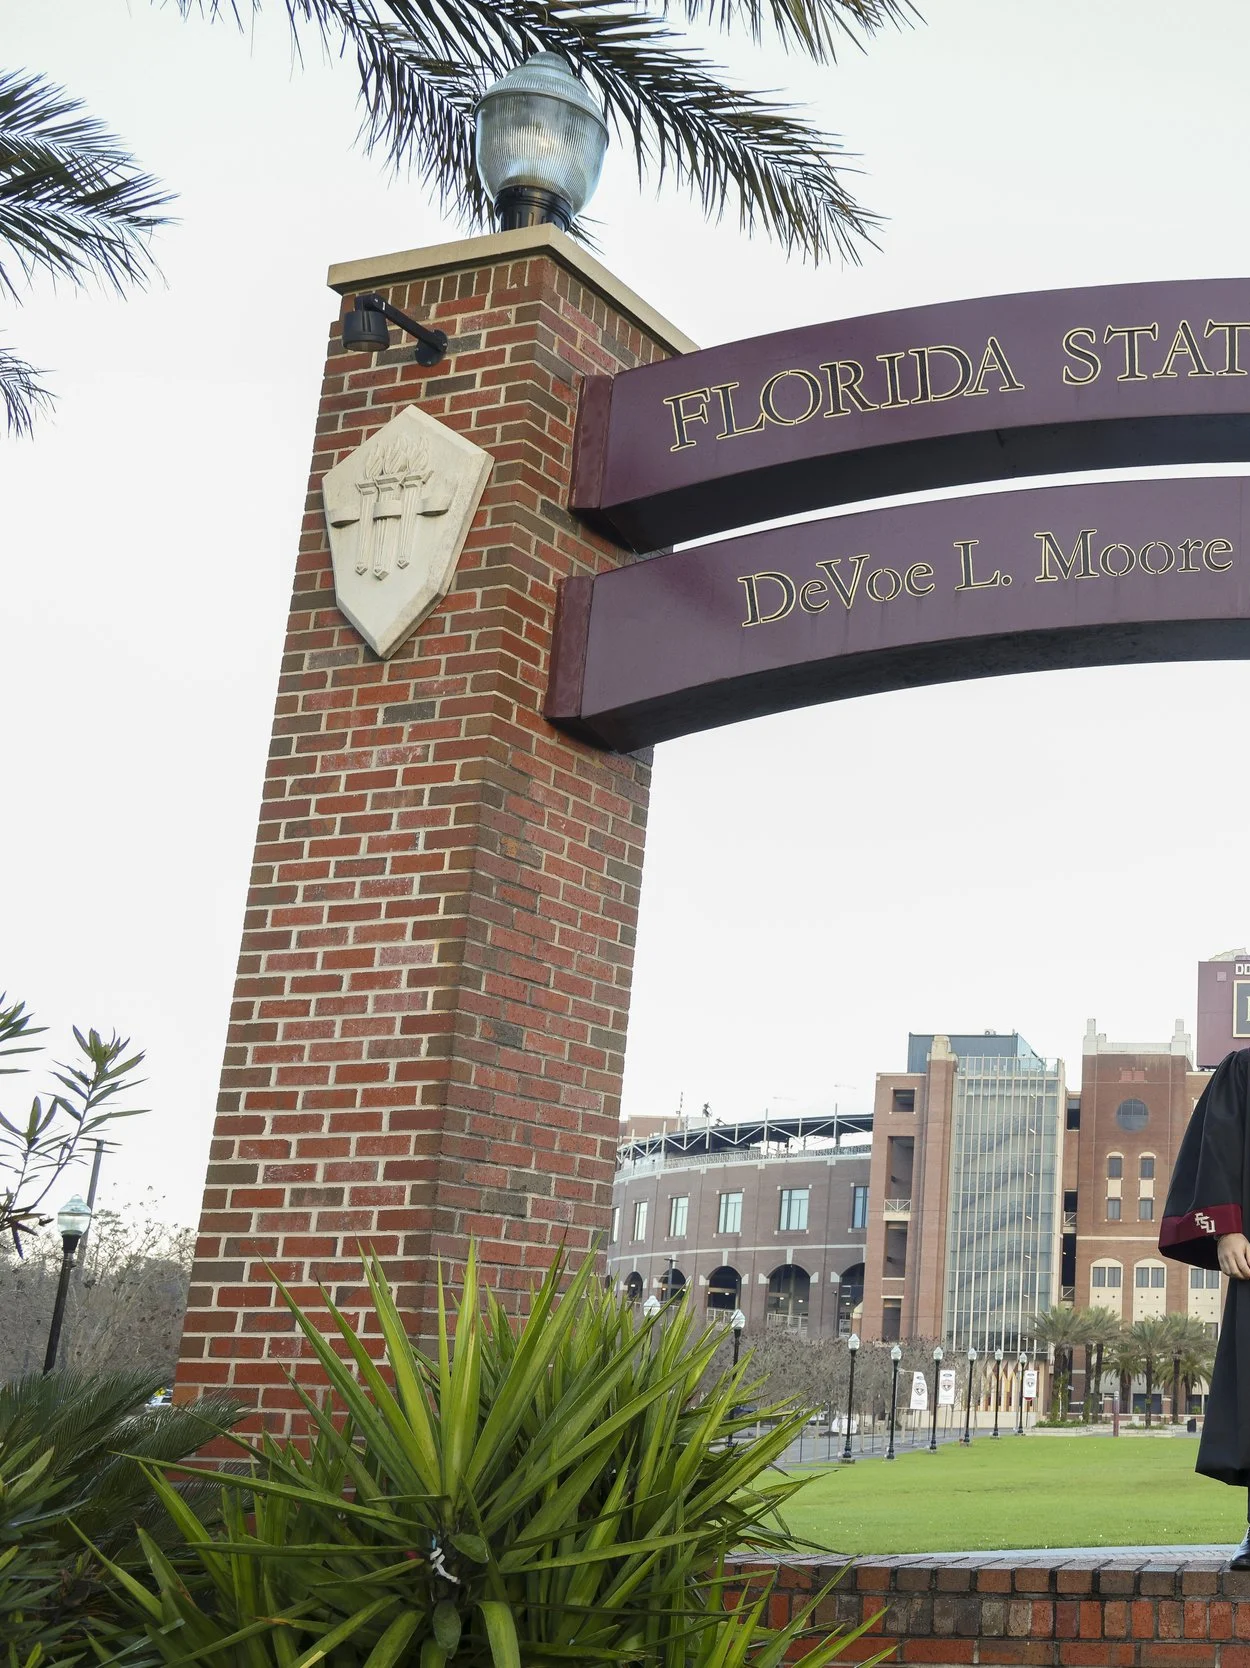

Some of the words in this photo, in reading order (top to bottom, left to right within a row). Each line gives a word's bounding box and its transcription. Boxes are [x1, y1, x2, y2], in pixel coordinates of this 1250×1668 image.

[663, 335, 1025, 452] FLORIDA
[737, 554, 935, 628] DeVoe
[953, 539, 1013, 592] L.
[1034, 528, 1235, 583] Moore
[1195, 1212, 1216, 1233] FSU
